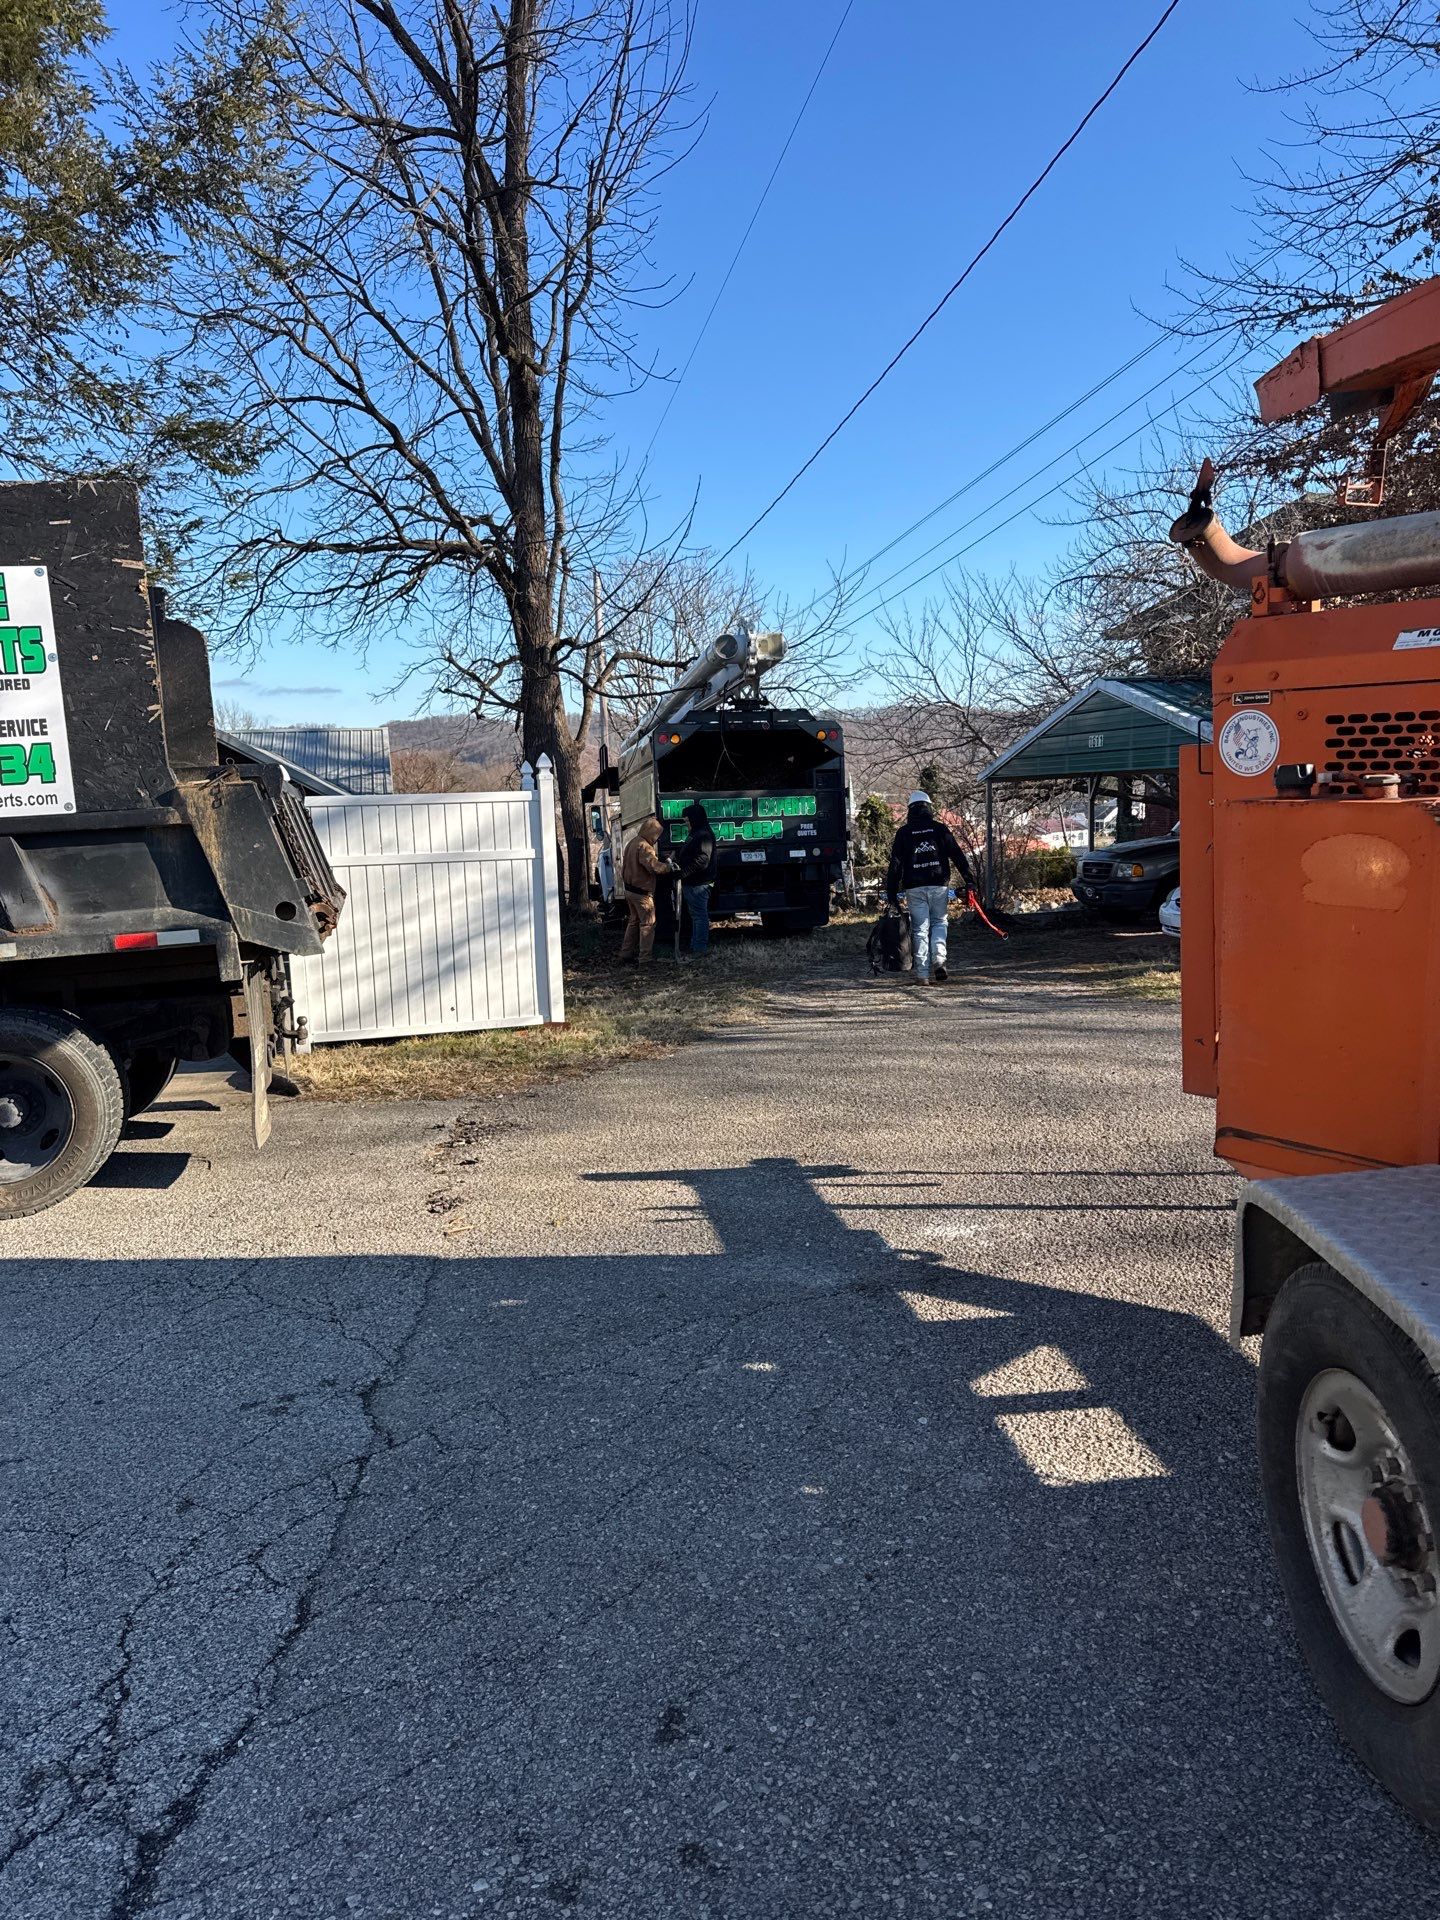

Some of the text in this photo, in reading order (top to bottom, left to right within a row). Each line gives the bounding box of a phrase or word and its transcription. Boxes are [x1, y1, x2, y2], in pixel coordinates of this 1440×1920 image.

[1224, 721, 1237, 744] BANDIT
[1237, 714, 1271, 731] INDUSTRIES
[1226, 751, 1243, 770] UNITED
[1255, 752, 1272, 770] STAND
[757, 795, 817, 818] EXPERTS
